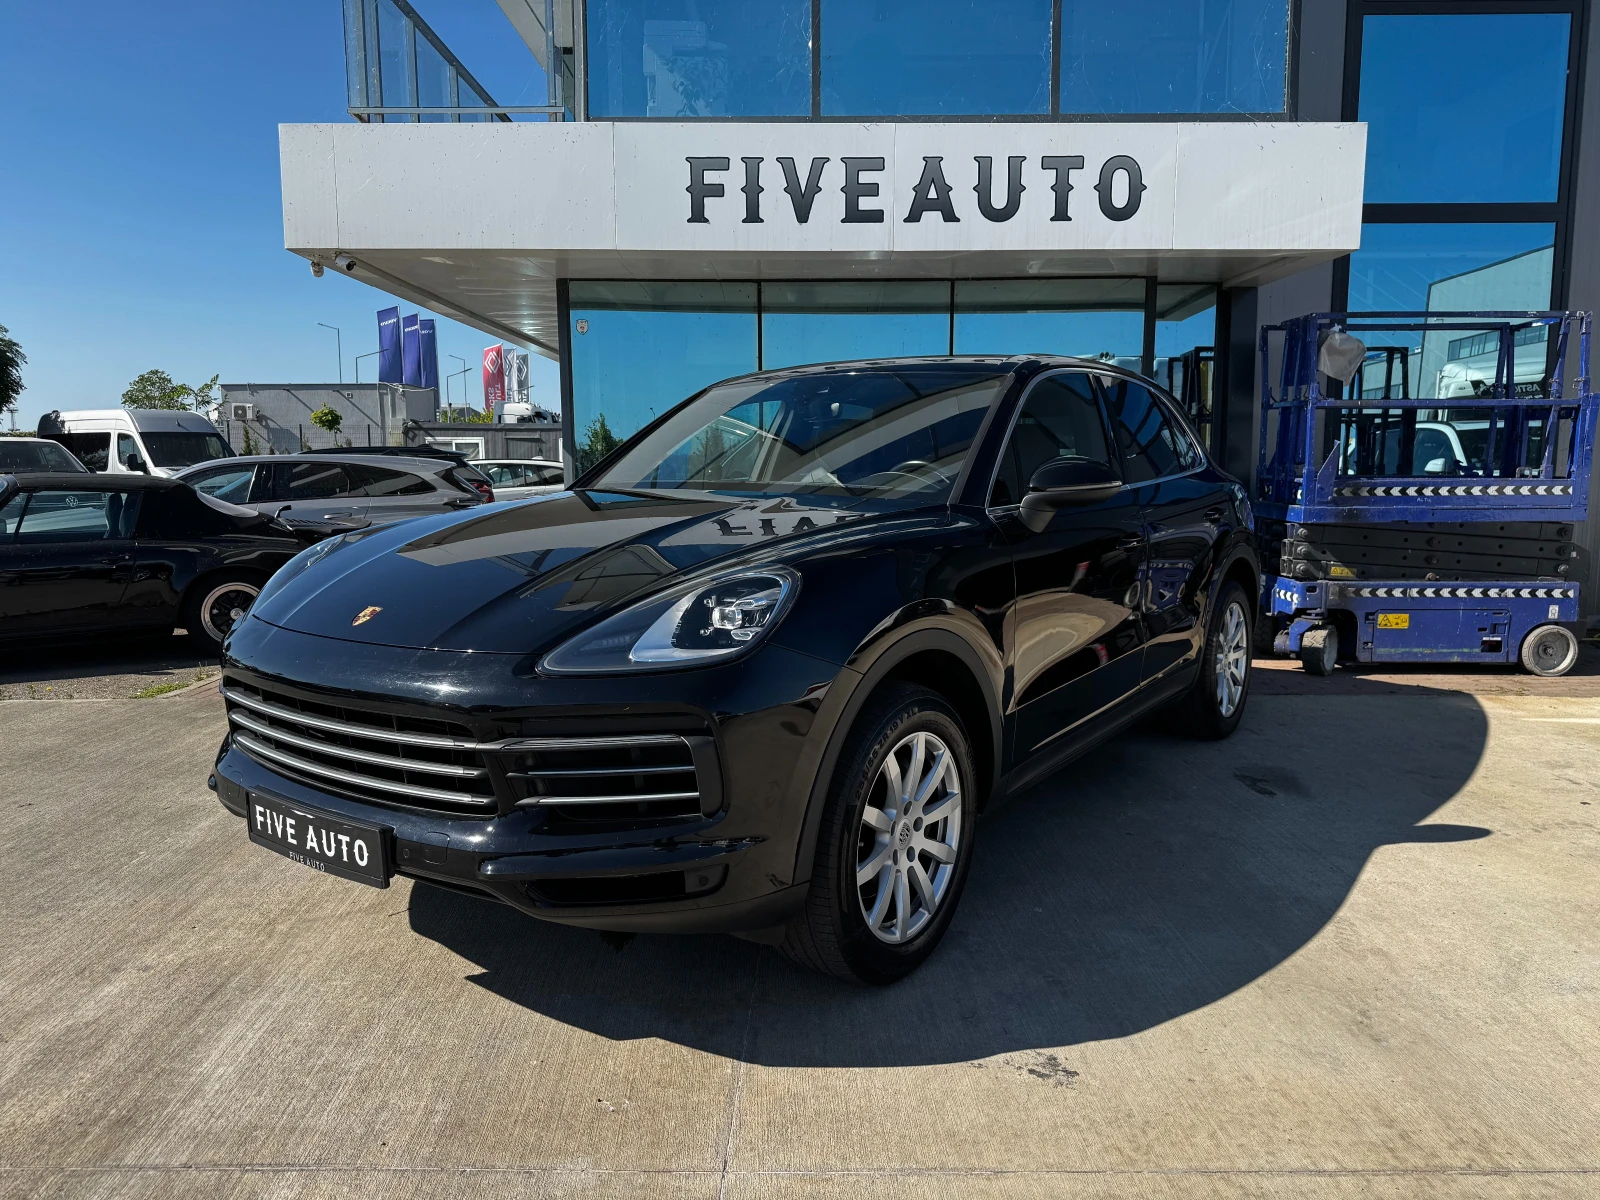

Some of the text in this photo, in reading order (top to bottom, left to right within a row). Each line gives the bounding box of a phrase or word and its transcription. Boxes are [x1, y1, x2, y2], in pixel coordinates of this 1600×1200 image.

[685, 154, 1148, 224] FIVE AUTO
[254, 804, 369, 867] FIVE AUTO
[289, 851, 325, 872] FIVE AUTO
